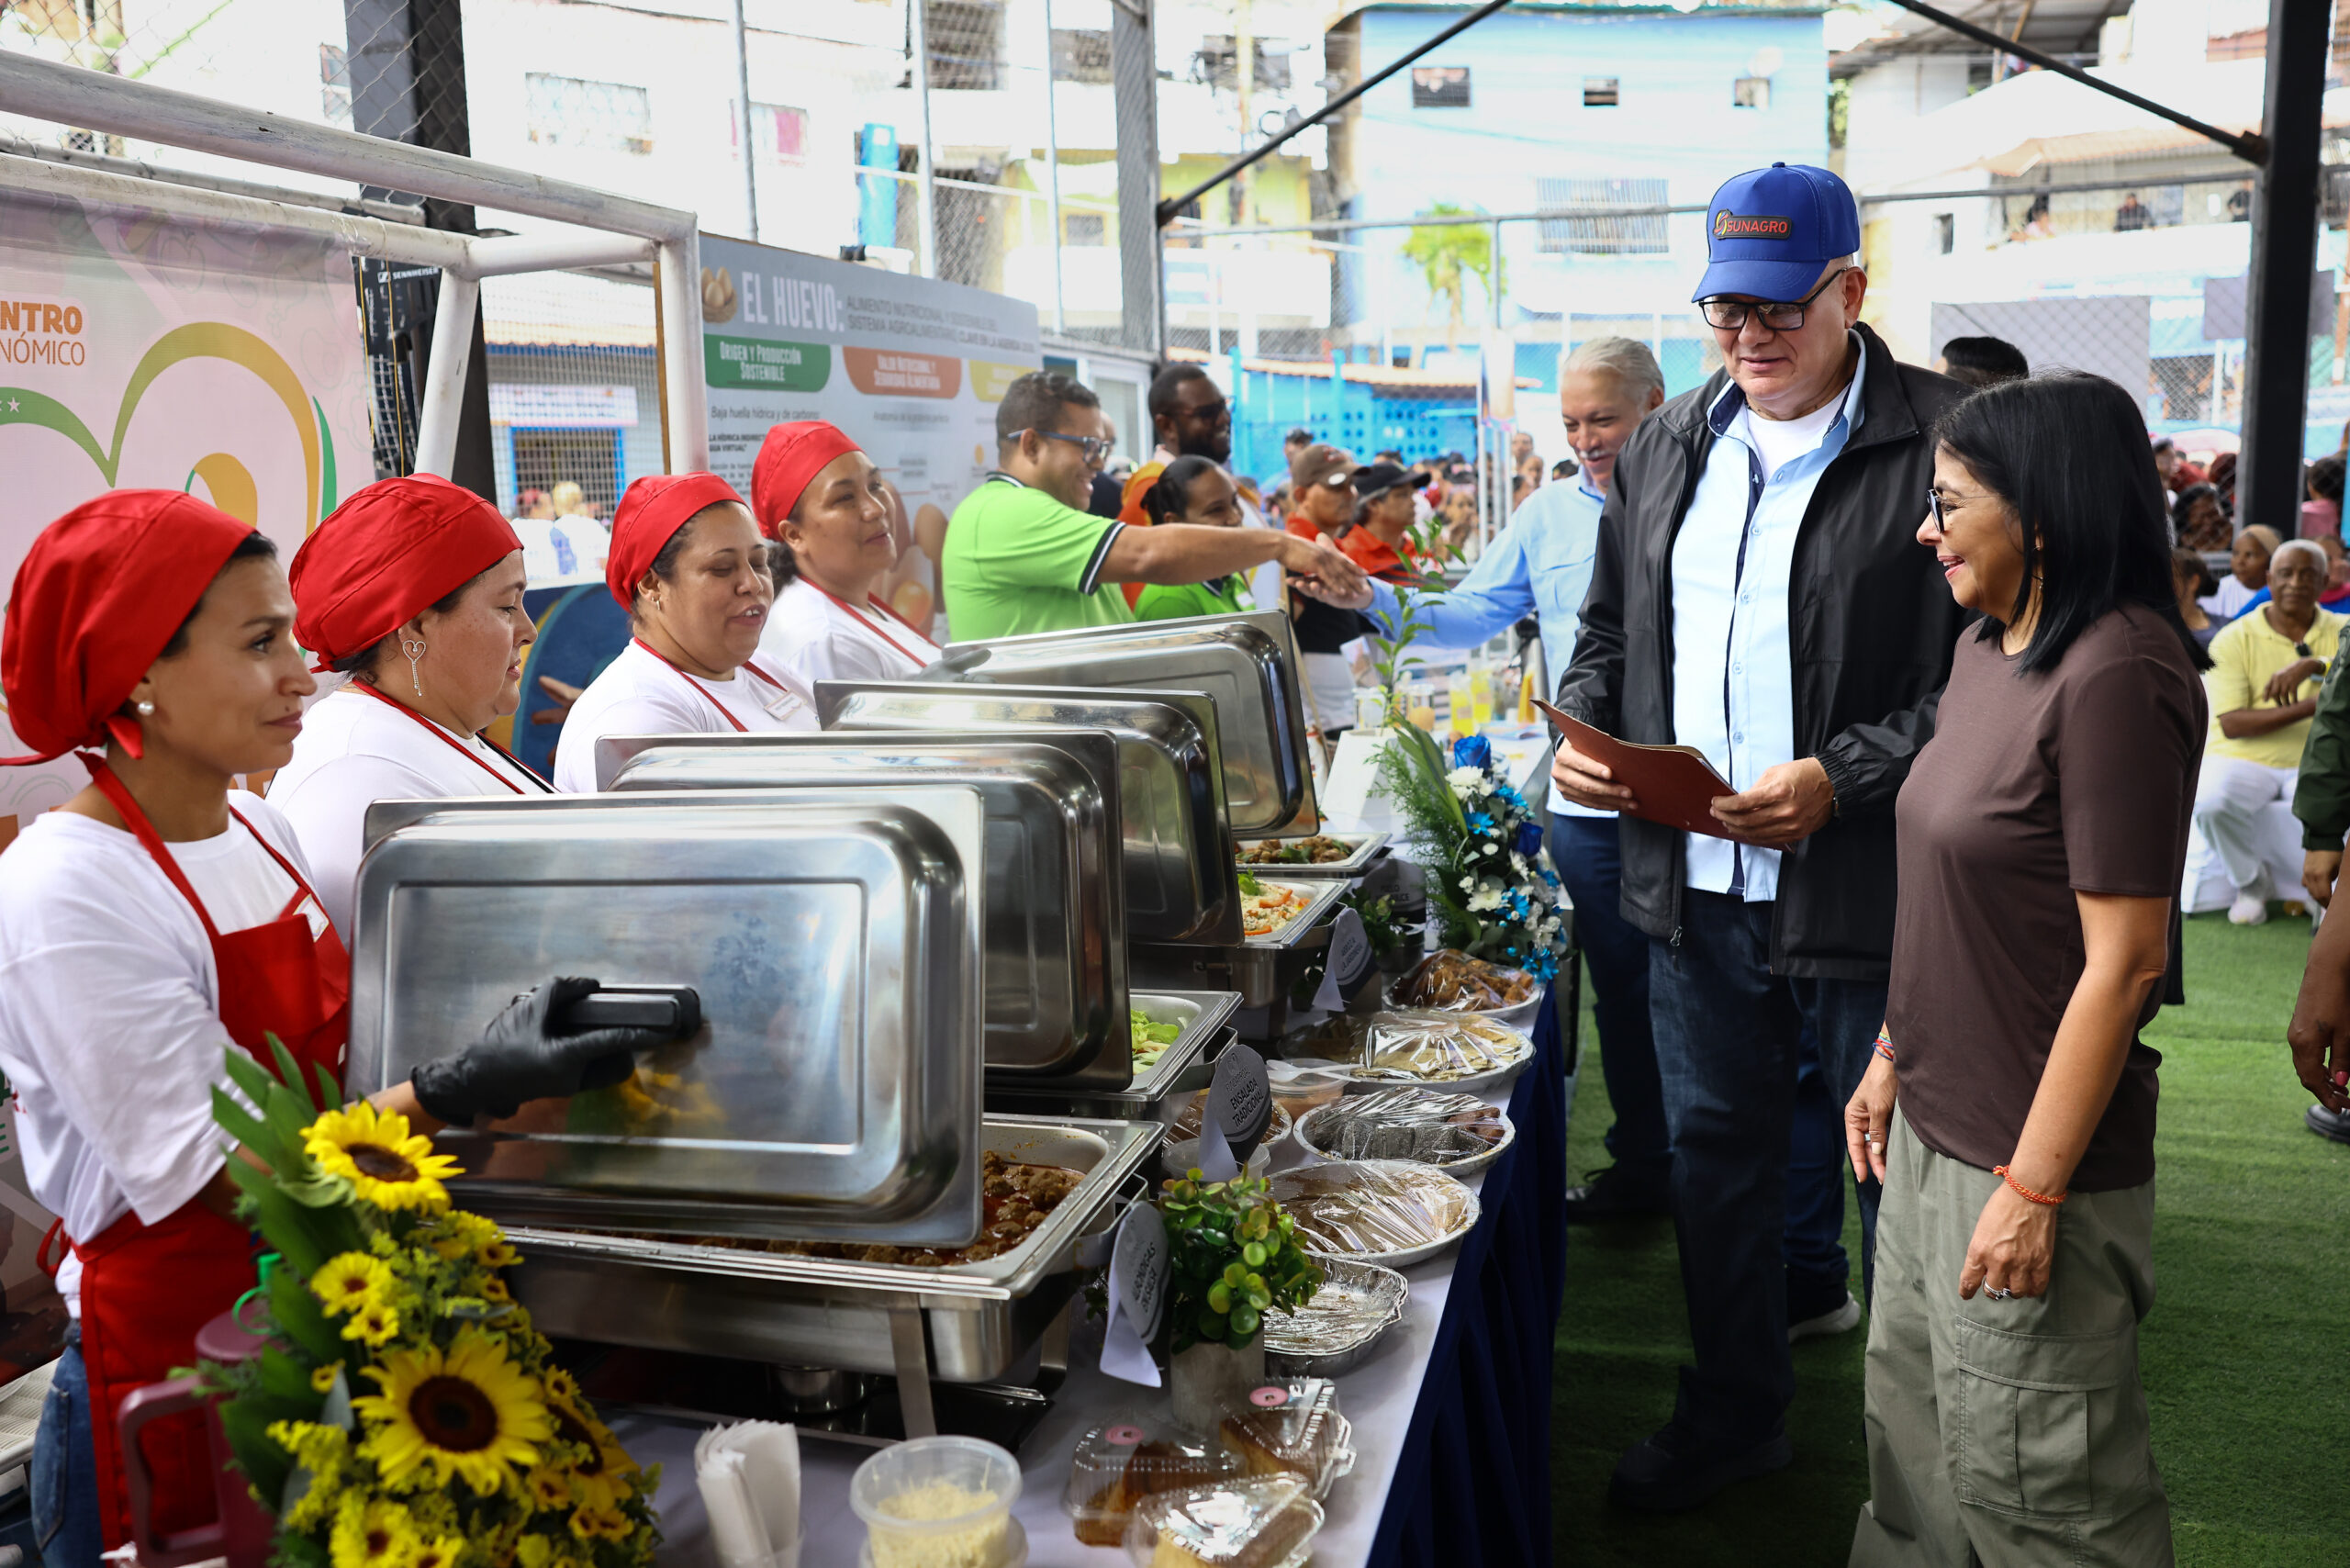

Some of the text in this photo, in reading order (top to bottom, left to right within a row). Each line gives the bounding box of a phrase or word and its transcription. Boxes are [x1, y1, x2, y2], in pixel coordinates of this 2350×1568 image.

[1727, 220, 1787, 233] SUNAGRO
[393, 267, 439, 280] SENNHEISER
[0, 301, 83, 335] NTRO
[742, 271, 845, 333] EL HUEVO:
[0, 330, 85, 366] NÓMICO
[1230, 1077, 1258, 1110] ENSALADA
[1232, 1089, 1264, 1127] TRADICIONAL
